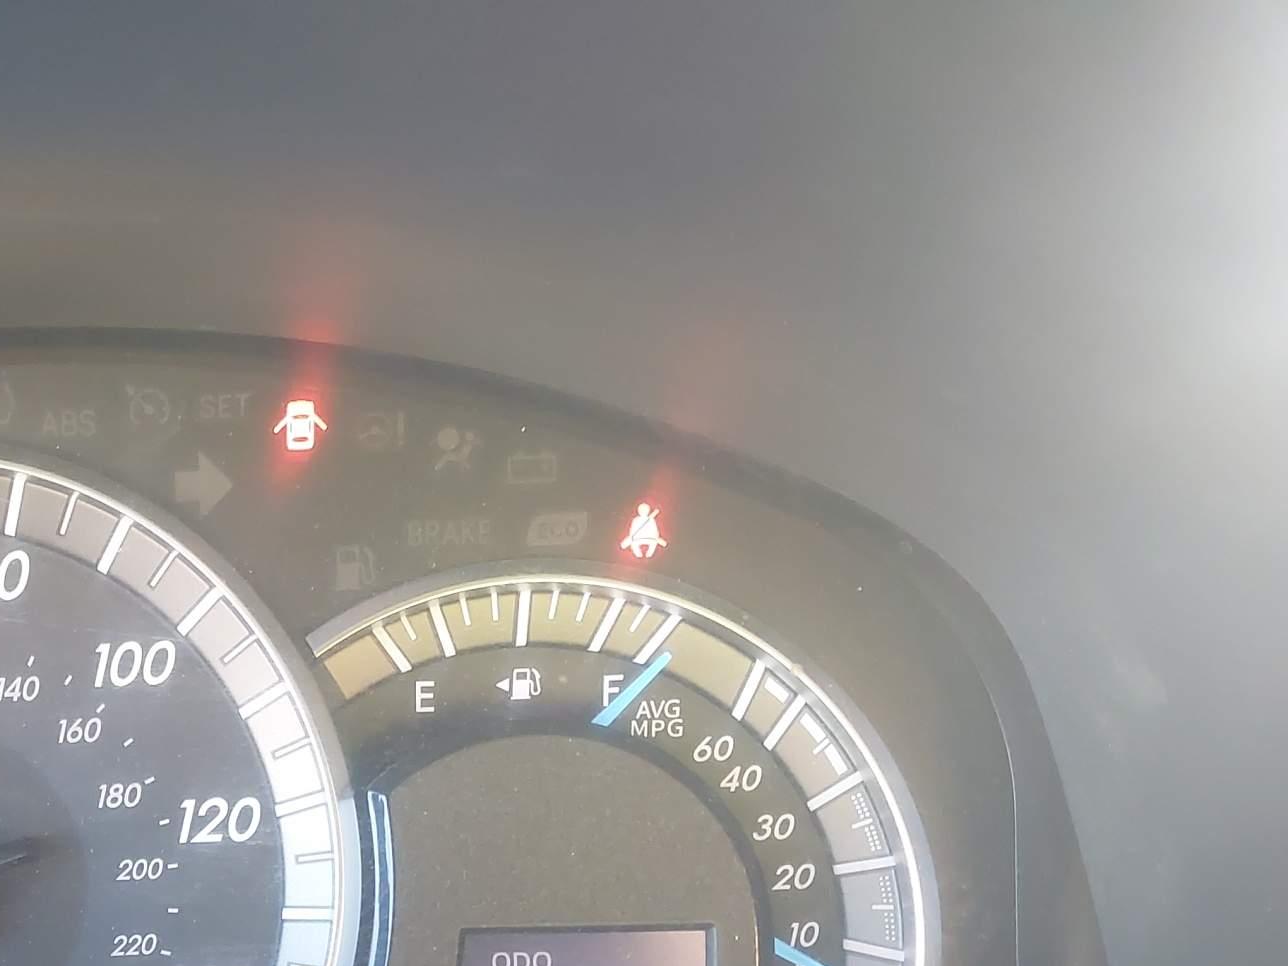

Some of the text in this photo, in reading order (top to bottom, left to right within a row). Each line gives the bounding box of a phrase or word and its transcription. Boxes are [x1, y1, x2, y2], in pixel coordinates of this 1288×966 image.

[199, 394, 250, 418] SET
[42, 411, 97, 436] ABS
[94, 640, 176, 688] 100
[415, 681, 434, 712] E
[602, 674, 624, 707] F
[636, 699, 681, 719] AVG
[58, 718, 102, 743] 160
[630, 719, 683, 738] MPG
[693, 735, 734, 762] 60
[720, 766, 761, 792] 40
[98, 783, 142, 809] 180
[179, 797, 261, 845] 120
[752, 814, 794, 841] 30
[116, 858, 164, 881] 200
[772, 864, 815, 890] 20
[110, 933, 157, 957] 220
[789, 921, 820, 948] 10
